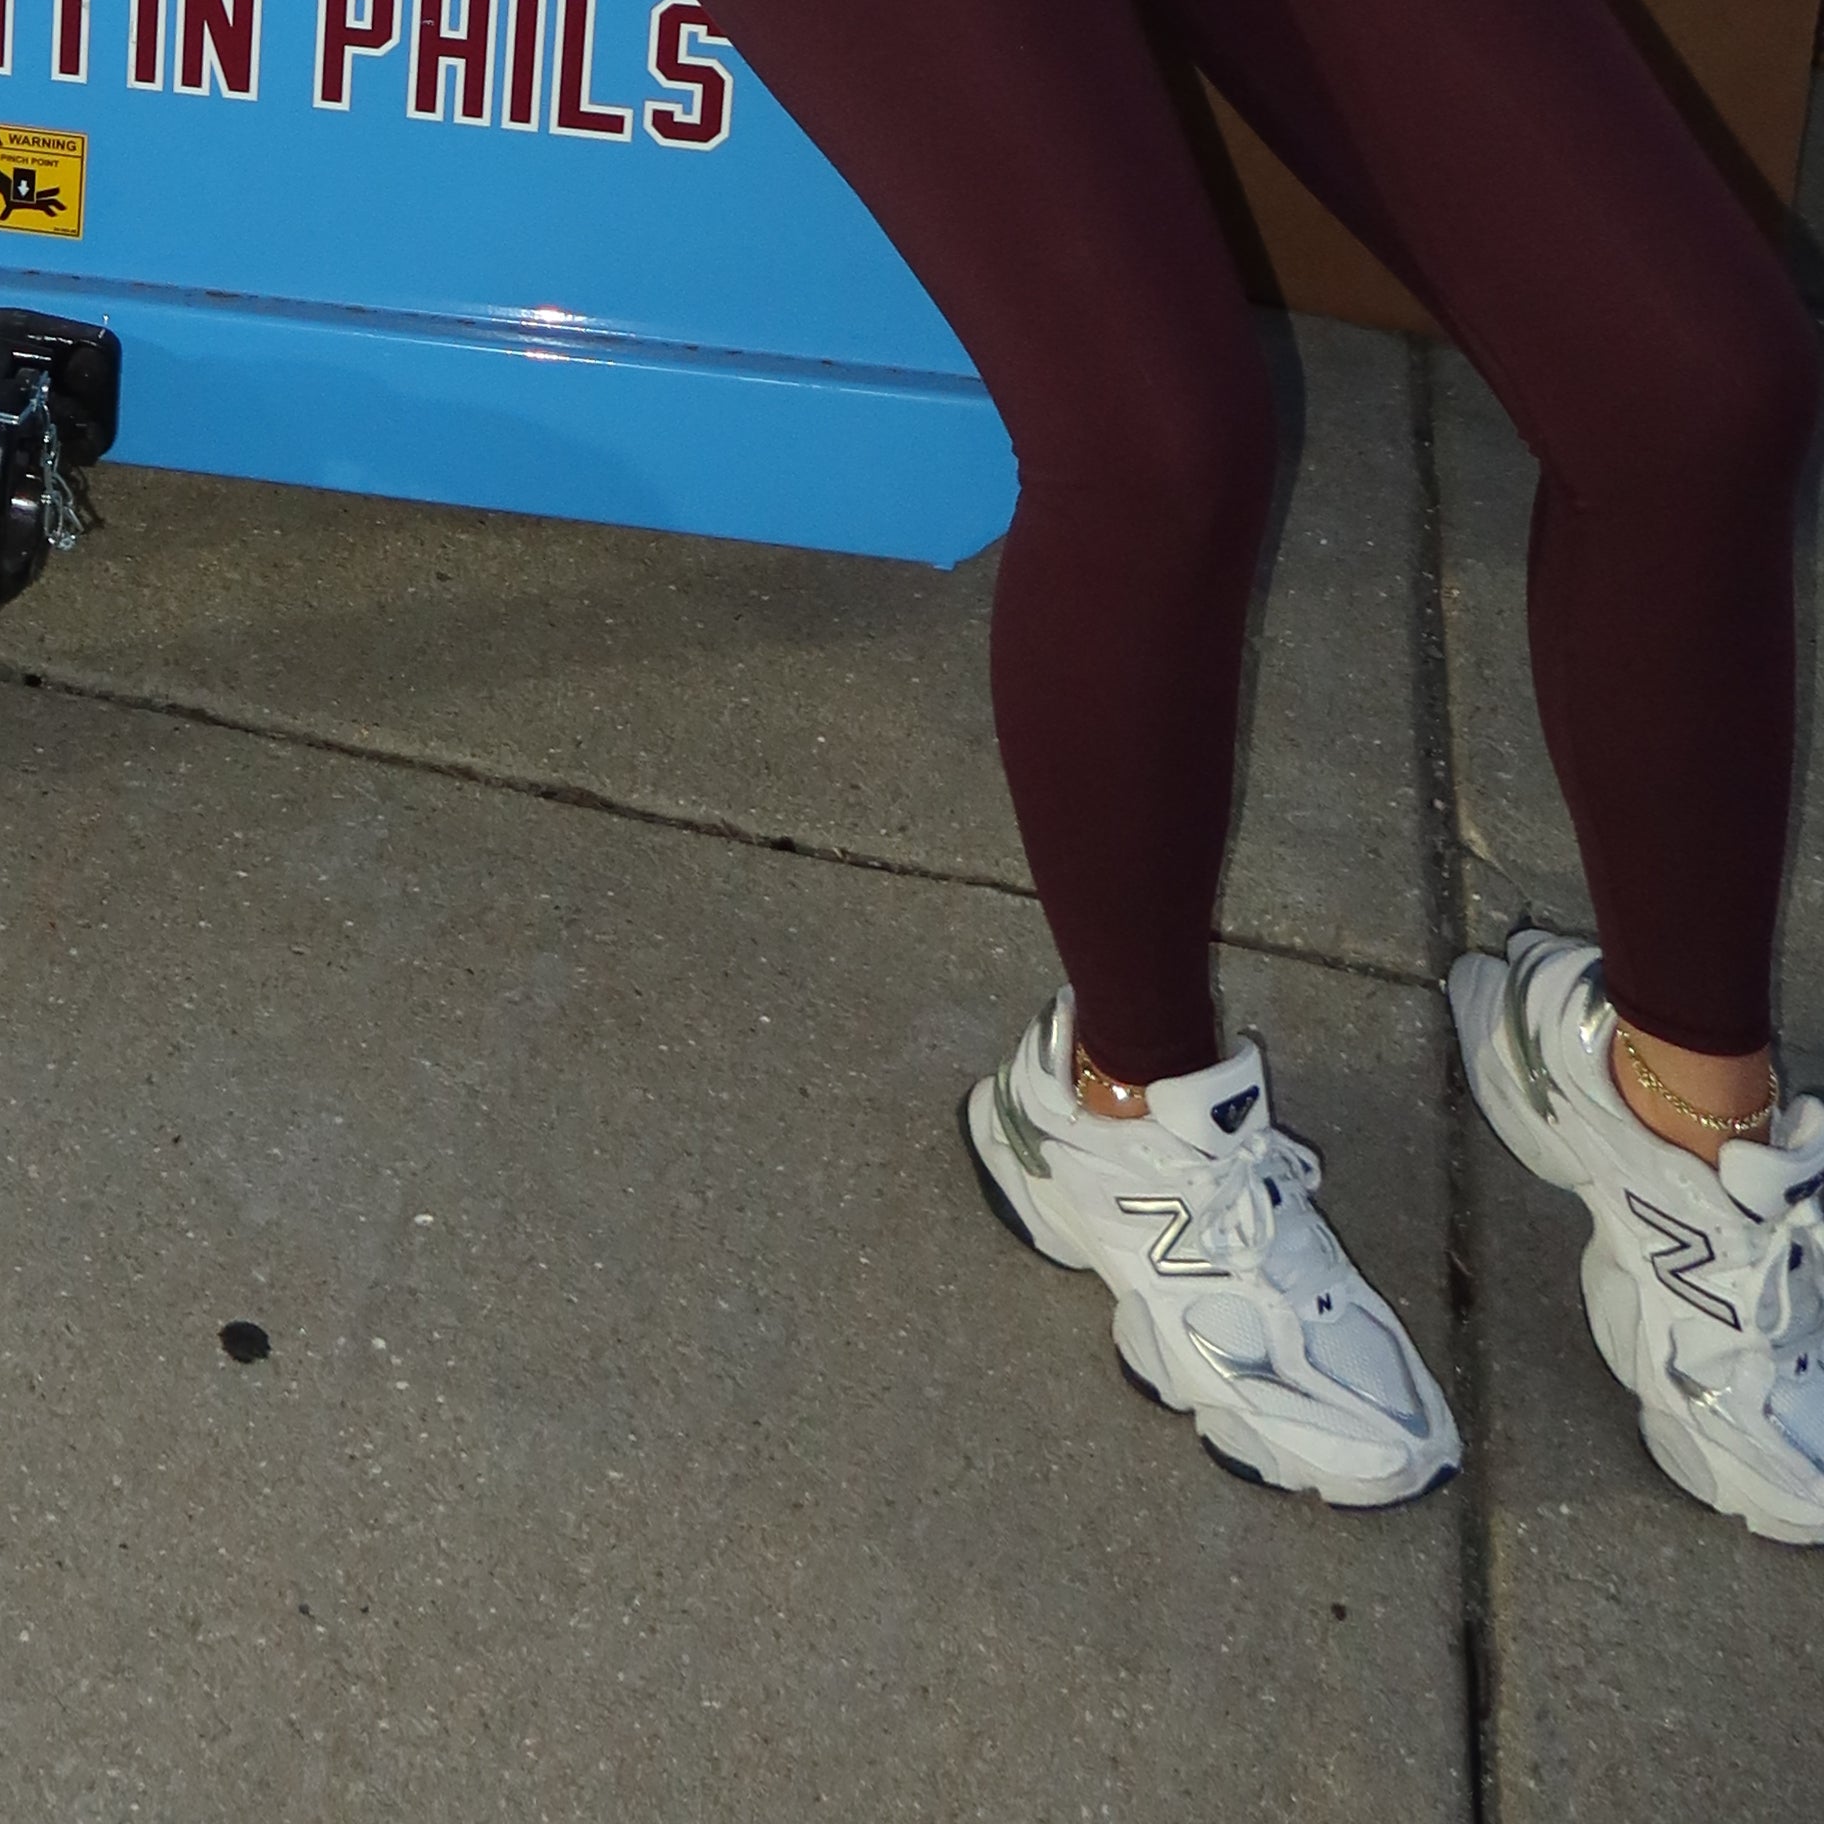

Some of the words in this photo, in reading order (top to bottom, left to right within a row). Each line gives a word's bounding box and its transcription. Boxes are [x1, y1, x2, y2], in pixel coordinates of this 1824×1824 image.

[8, 133, 77, 151] WARNING
[0, 154, 28, 165] PINCH
[31, 157, 59, 168] POINT
